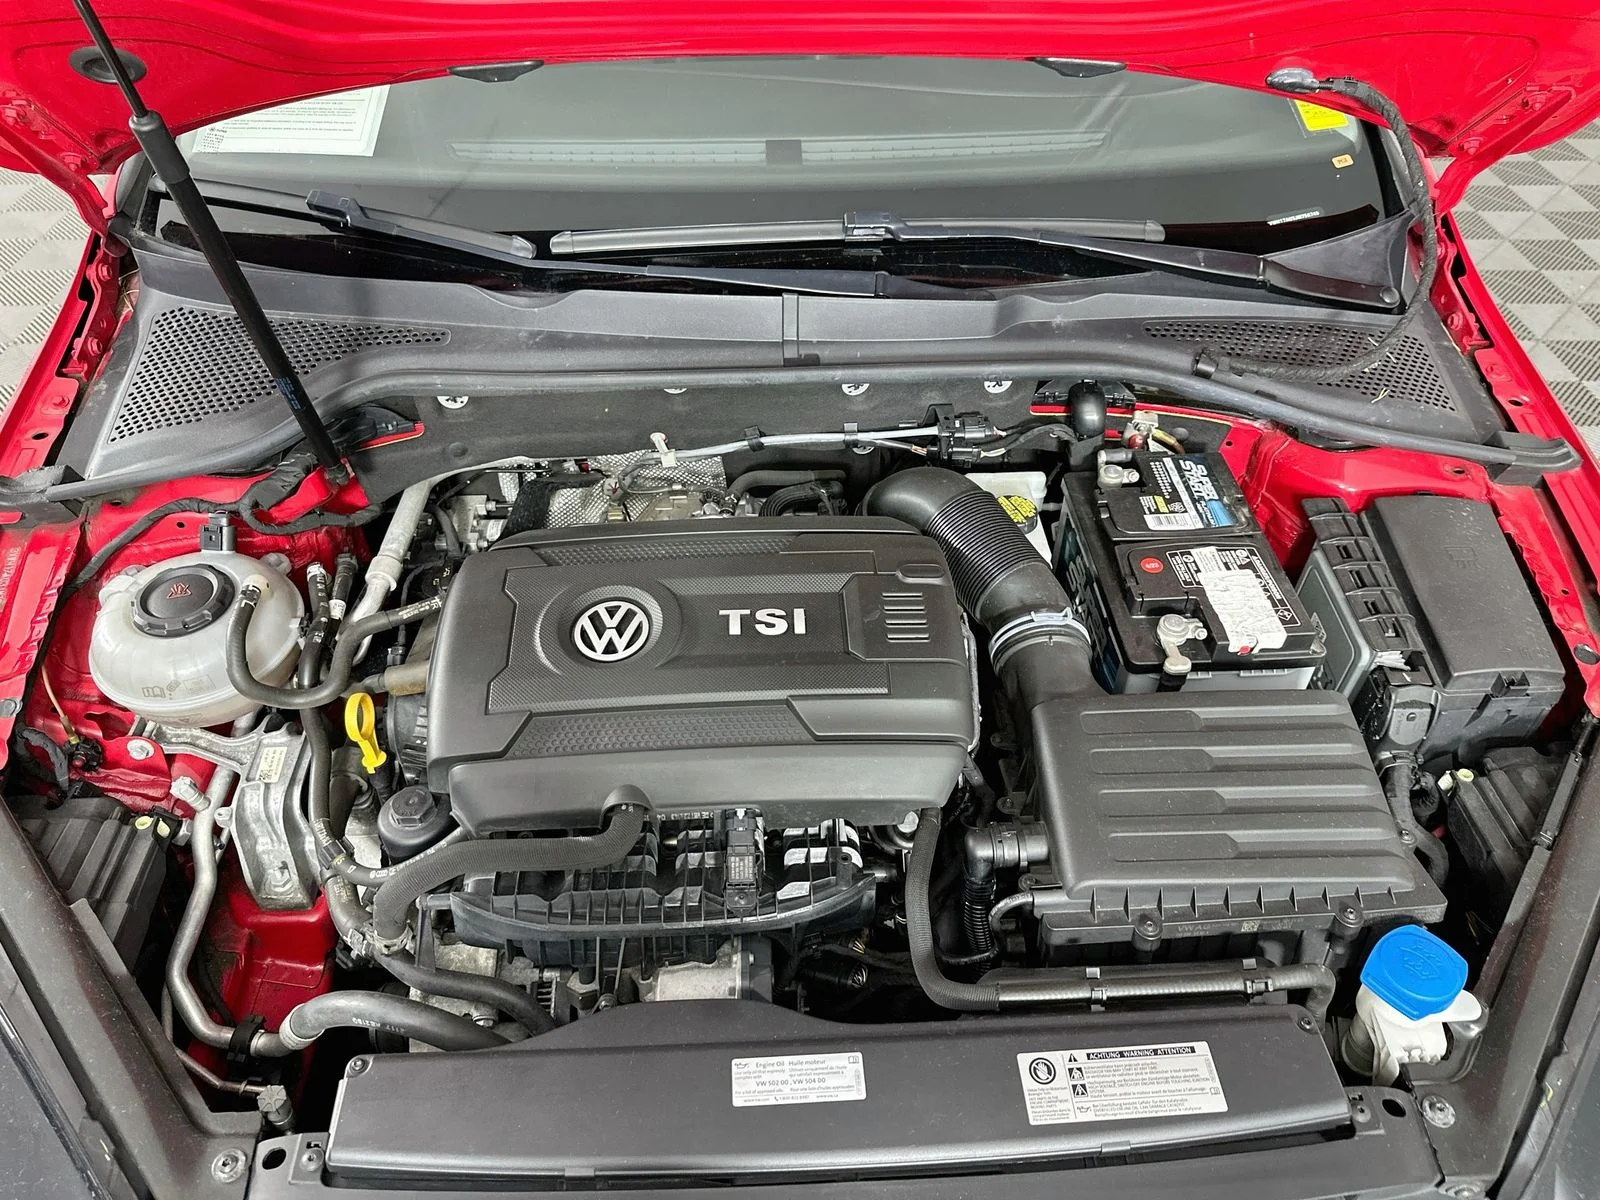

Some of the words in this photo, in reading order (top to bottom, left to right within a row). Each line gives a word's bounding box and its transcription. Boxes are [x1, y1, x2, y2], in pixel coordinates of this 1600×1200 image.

[718, 608, 807, 635] TSI
[1090, 1051, 1120, 1060] ACHTUNG
[1122, 1049, 1155, 1057] WARNING
[1157, 1046, 1192, 1055] ATTENTION
